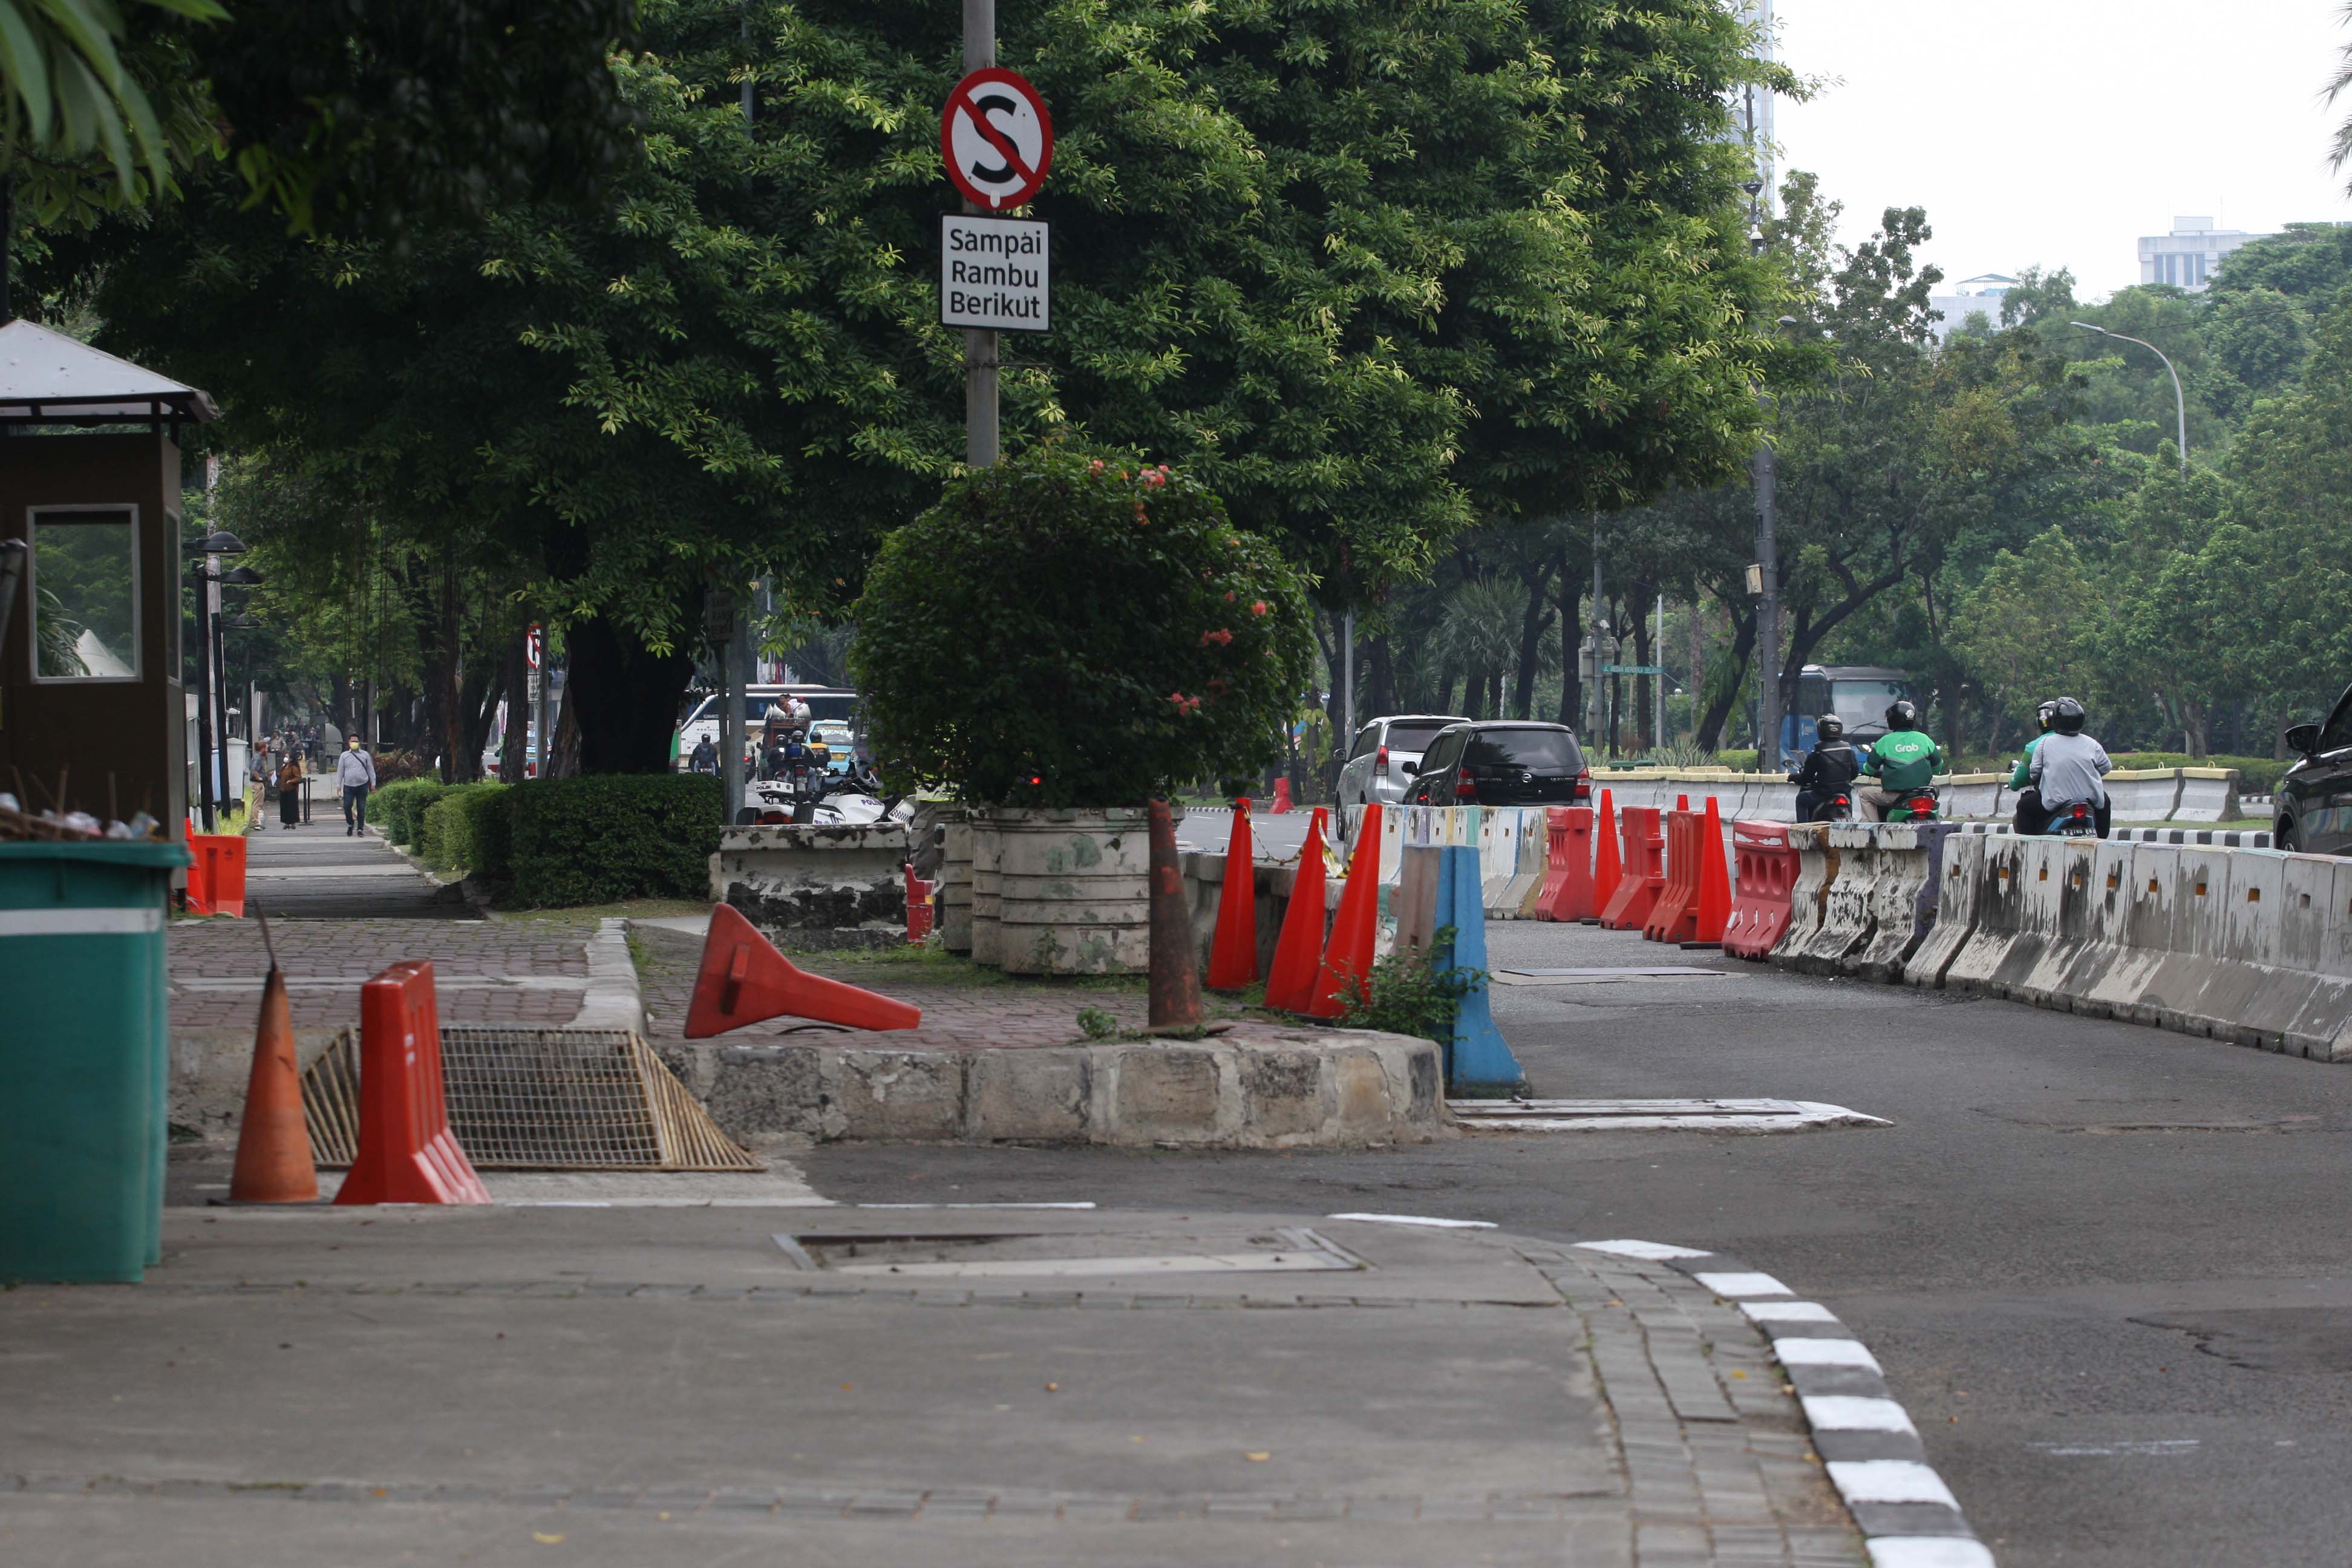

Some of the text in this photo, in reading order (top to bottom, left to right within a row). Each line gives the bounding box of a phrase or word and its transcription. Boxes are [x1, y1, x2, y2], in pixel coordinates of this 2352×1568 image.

[972, 95, 1020, 183] S
[950, 229, 1041, 258] Sampai
[952, 260, 1039, 288] Rambu
[950, 291, 1040, 318] Berikut
[1895, 743, 1919, 753] Grab
